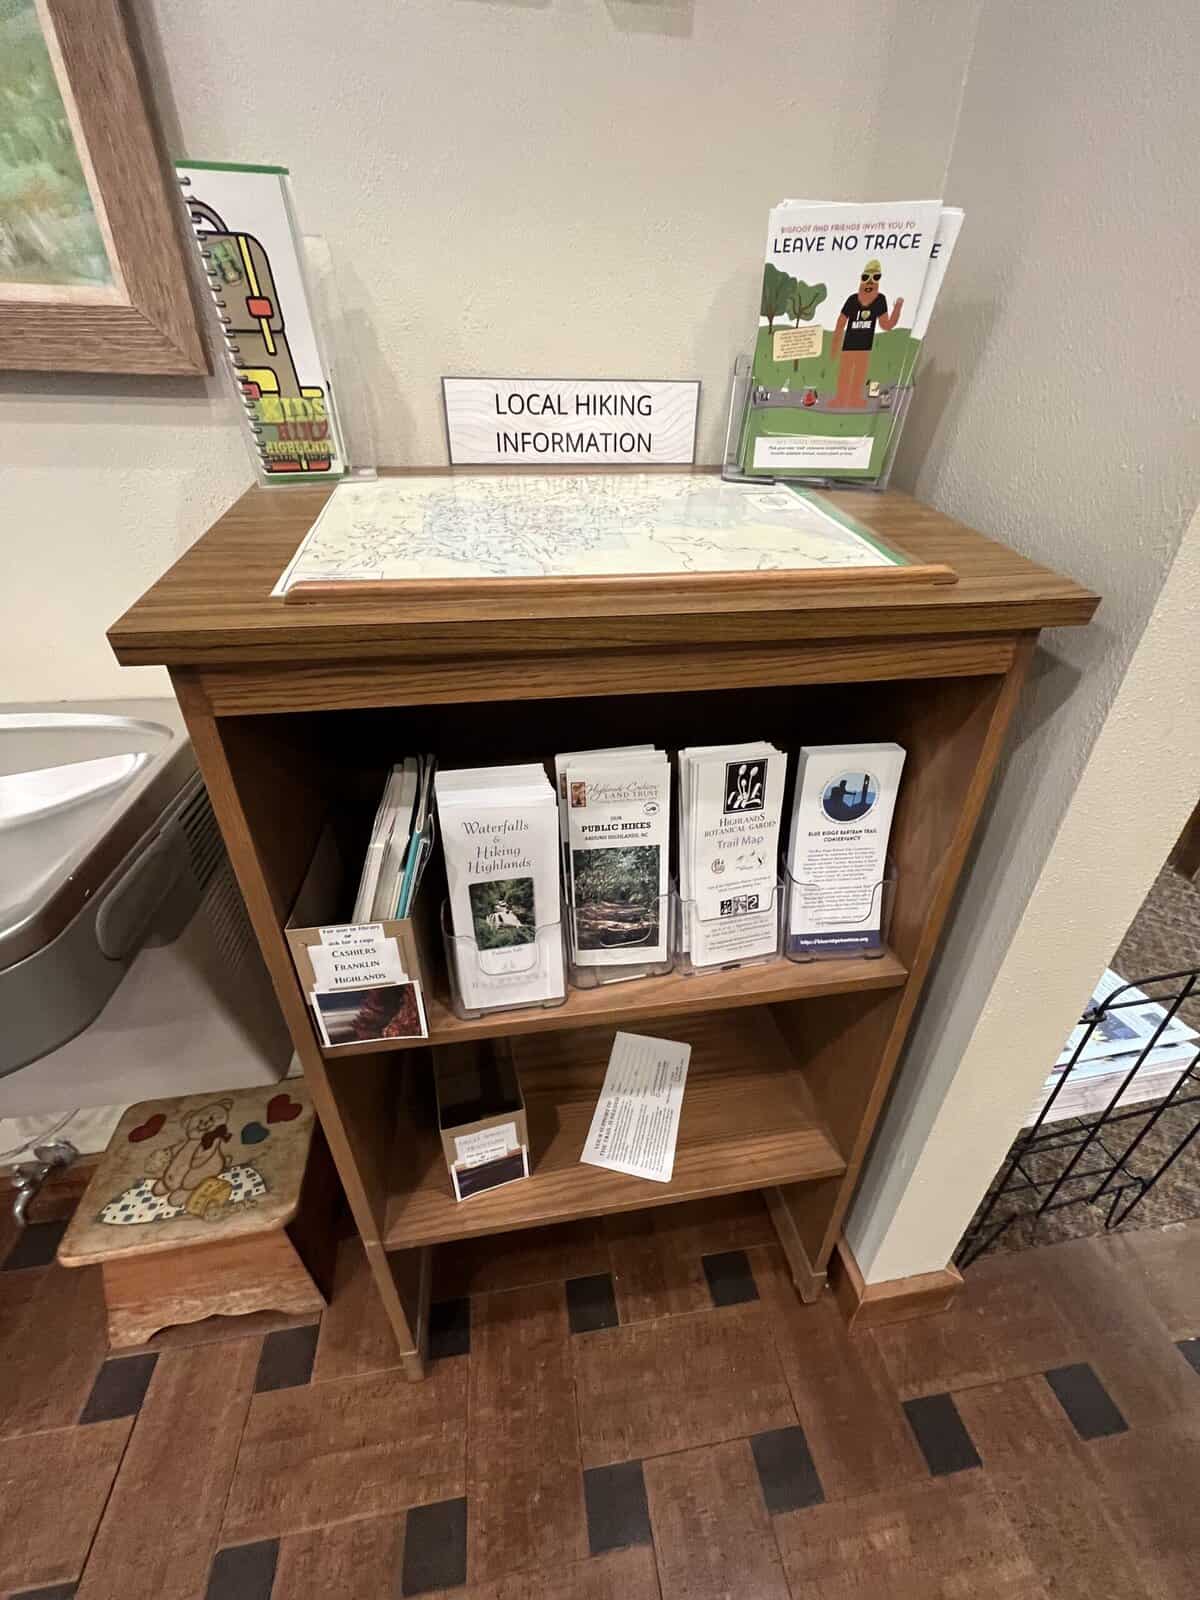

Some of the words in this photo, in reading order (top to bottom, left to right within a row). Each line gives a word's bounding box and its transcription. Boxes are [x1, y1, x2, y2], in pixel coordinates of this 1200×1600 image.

[830, 223, 861, 232] FRIENDS
[862, 222, 887, 231] INVITE
[888, 221, 904, 230] YOU
[774, 237, 826, 253] LEAVE
[831, 235, 858, 251] NO
[864, 233, 922, 250] TRACE
[851, 320, 872, 329] NATURE
[495, 392, 569, 416] LOCAL
[575, 394, 653, 417] HIKING
[496, 431, 653, 454] INFORMATION
[463, 819, 529, 835] Waterfalls
[581, 824, 619, 833] PUBLIC
[621, 821, 652, 831] HIKES
[704, 826, 745, 838] BOTANICAL
[748, 820, 777, 831] GARDEN
[717, 837, 740, 849] Trail
[741, 834, 765, 846] Map
[475, 845, 521, 859] Hiking
[467, 858, 532, 873] Highlands
[334, 961, 380, 972] FRANKLIN
